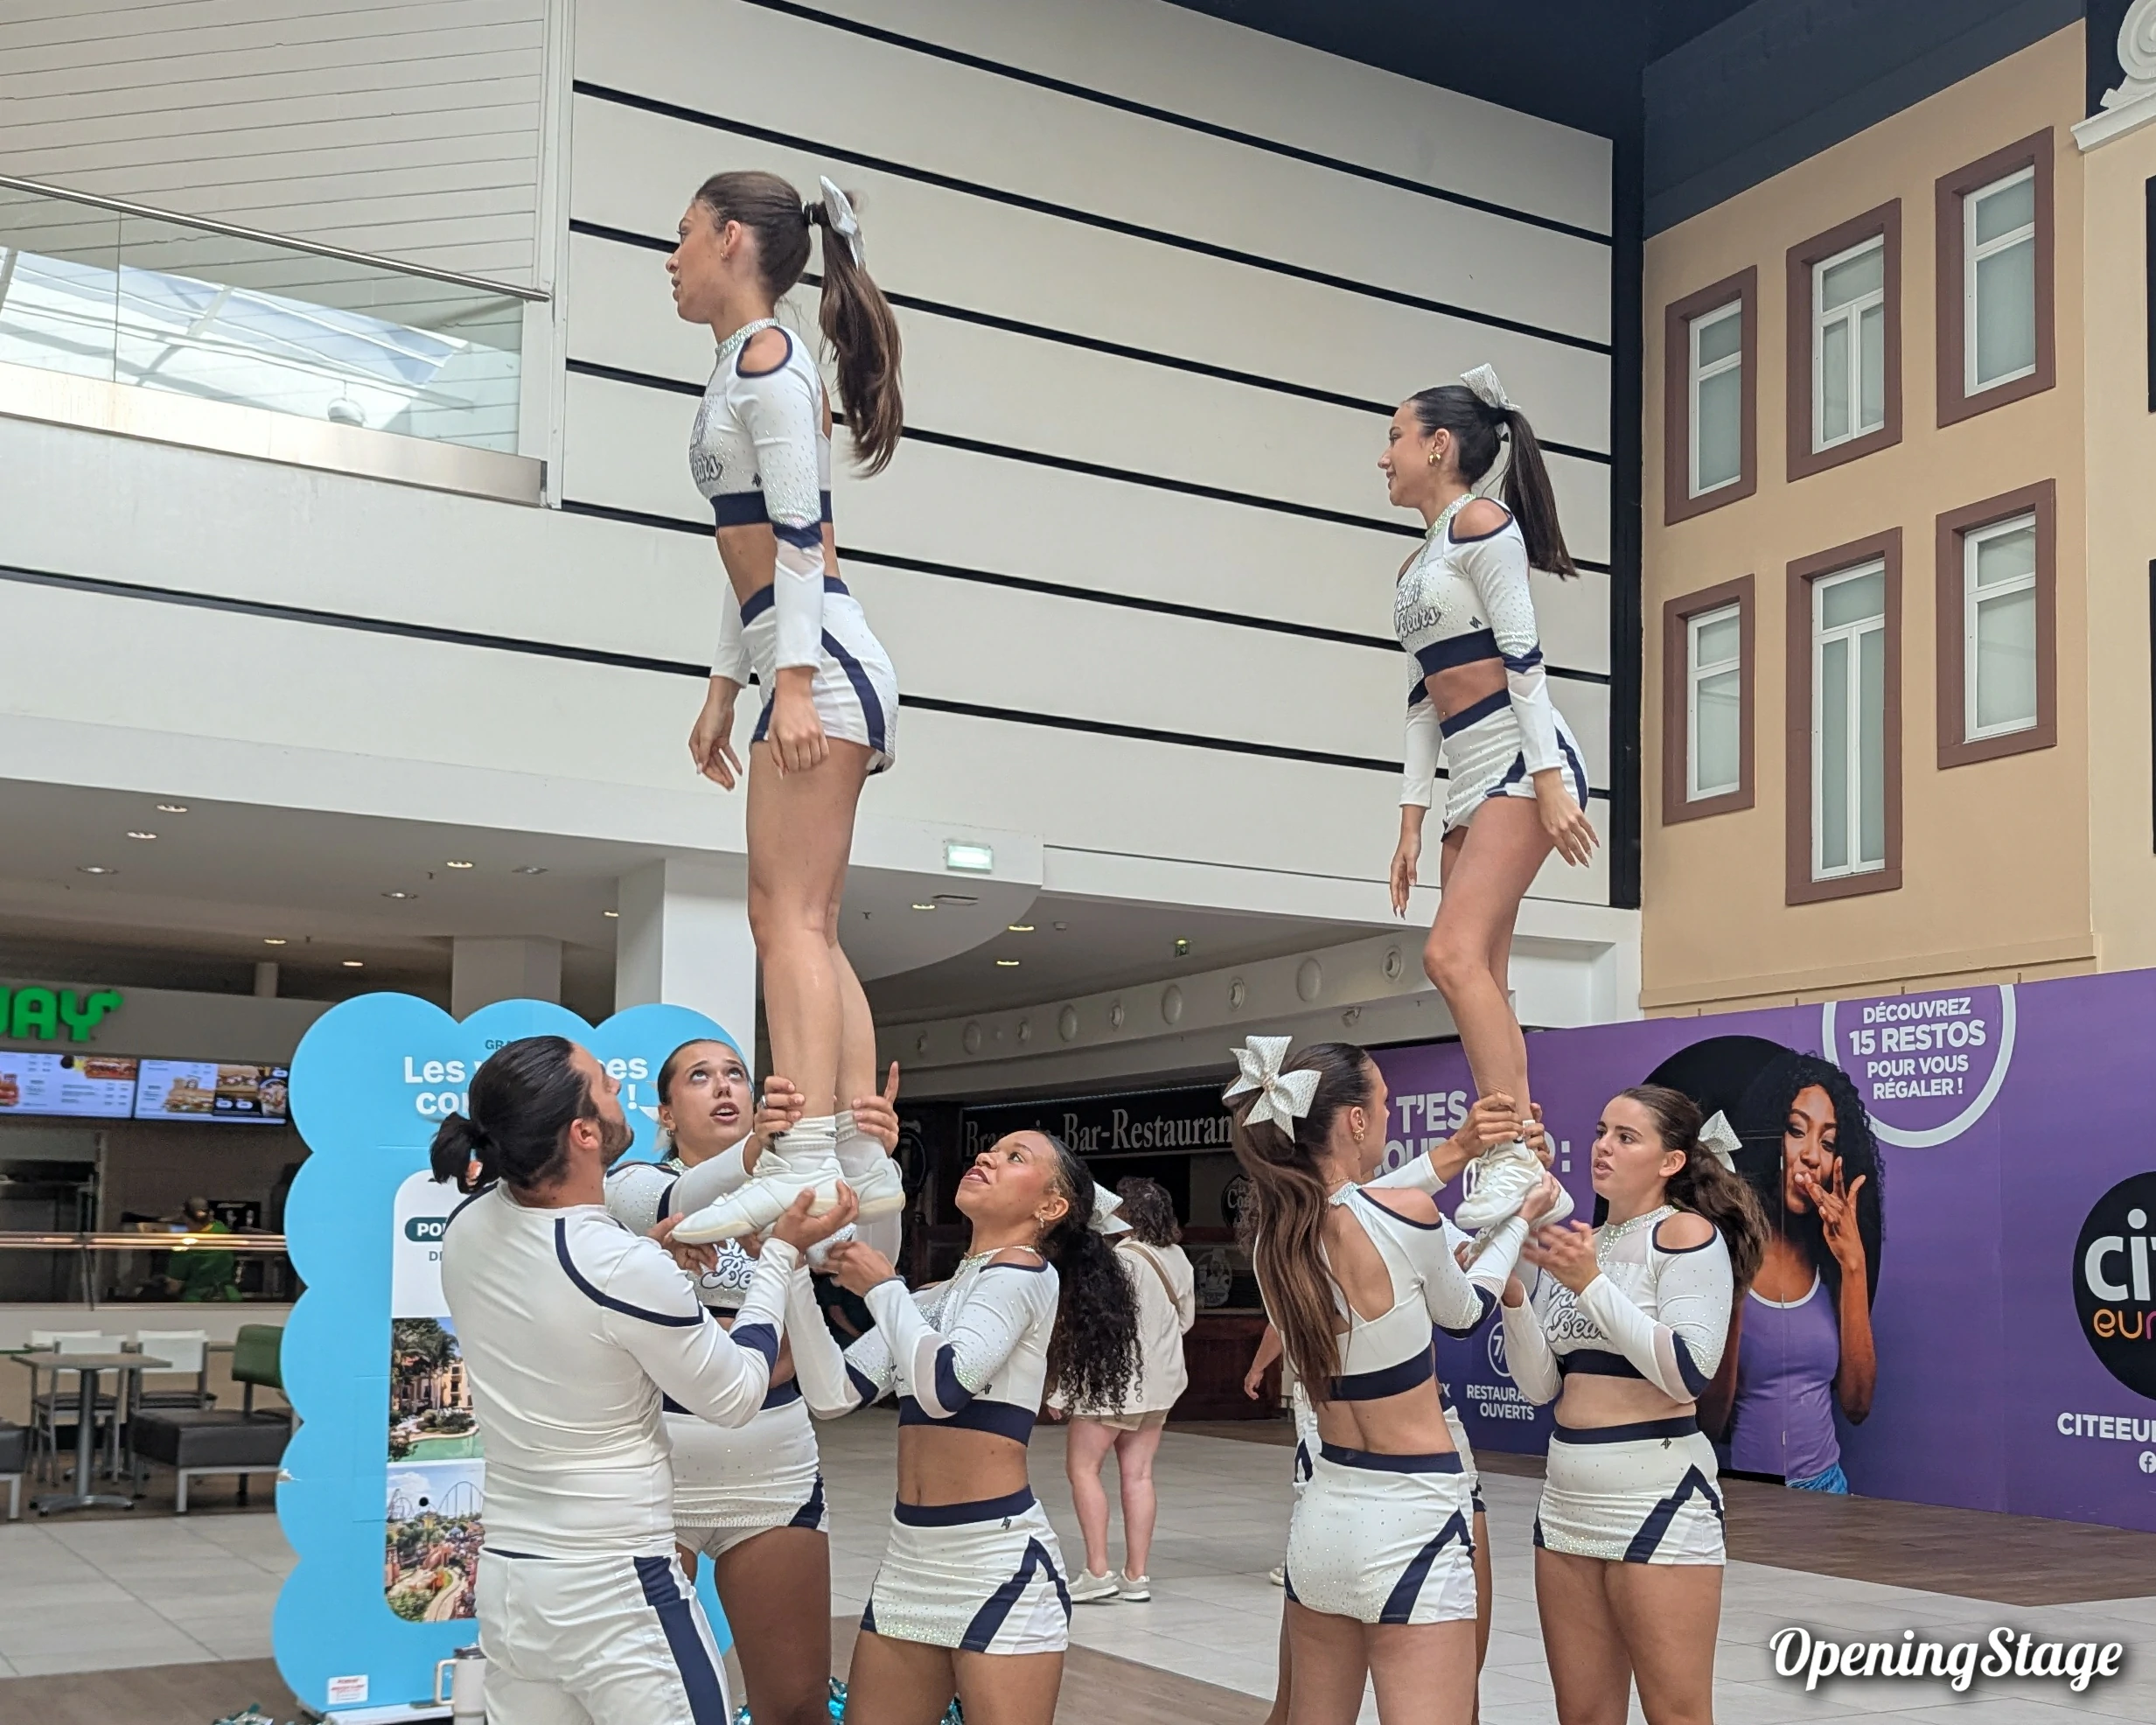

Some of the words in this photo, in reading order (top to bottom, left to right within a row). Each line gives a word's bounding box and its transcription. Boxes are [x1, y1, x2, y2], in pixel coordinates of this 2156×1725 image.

[0, 986, 124, 1042] AY
[1863, 997, 1971, 1024] DÉCOUVREZ
[1849, 1030, 1876, 1056] 15
[1881, 1019, 1986, 1053] RESTOS
[404, 1056, 465, 1084] Les
[1866, 1058, 1915, 1079] POUR
[1919, 1054, 1969, 1074] VOUS
[1873, 1078, 1954, 1100] RÉGALER
[1479, 1402, 1535, 1421] OUVERTS
[2056, 1412, 2156, 1442] CITEEU
